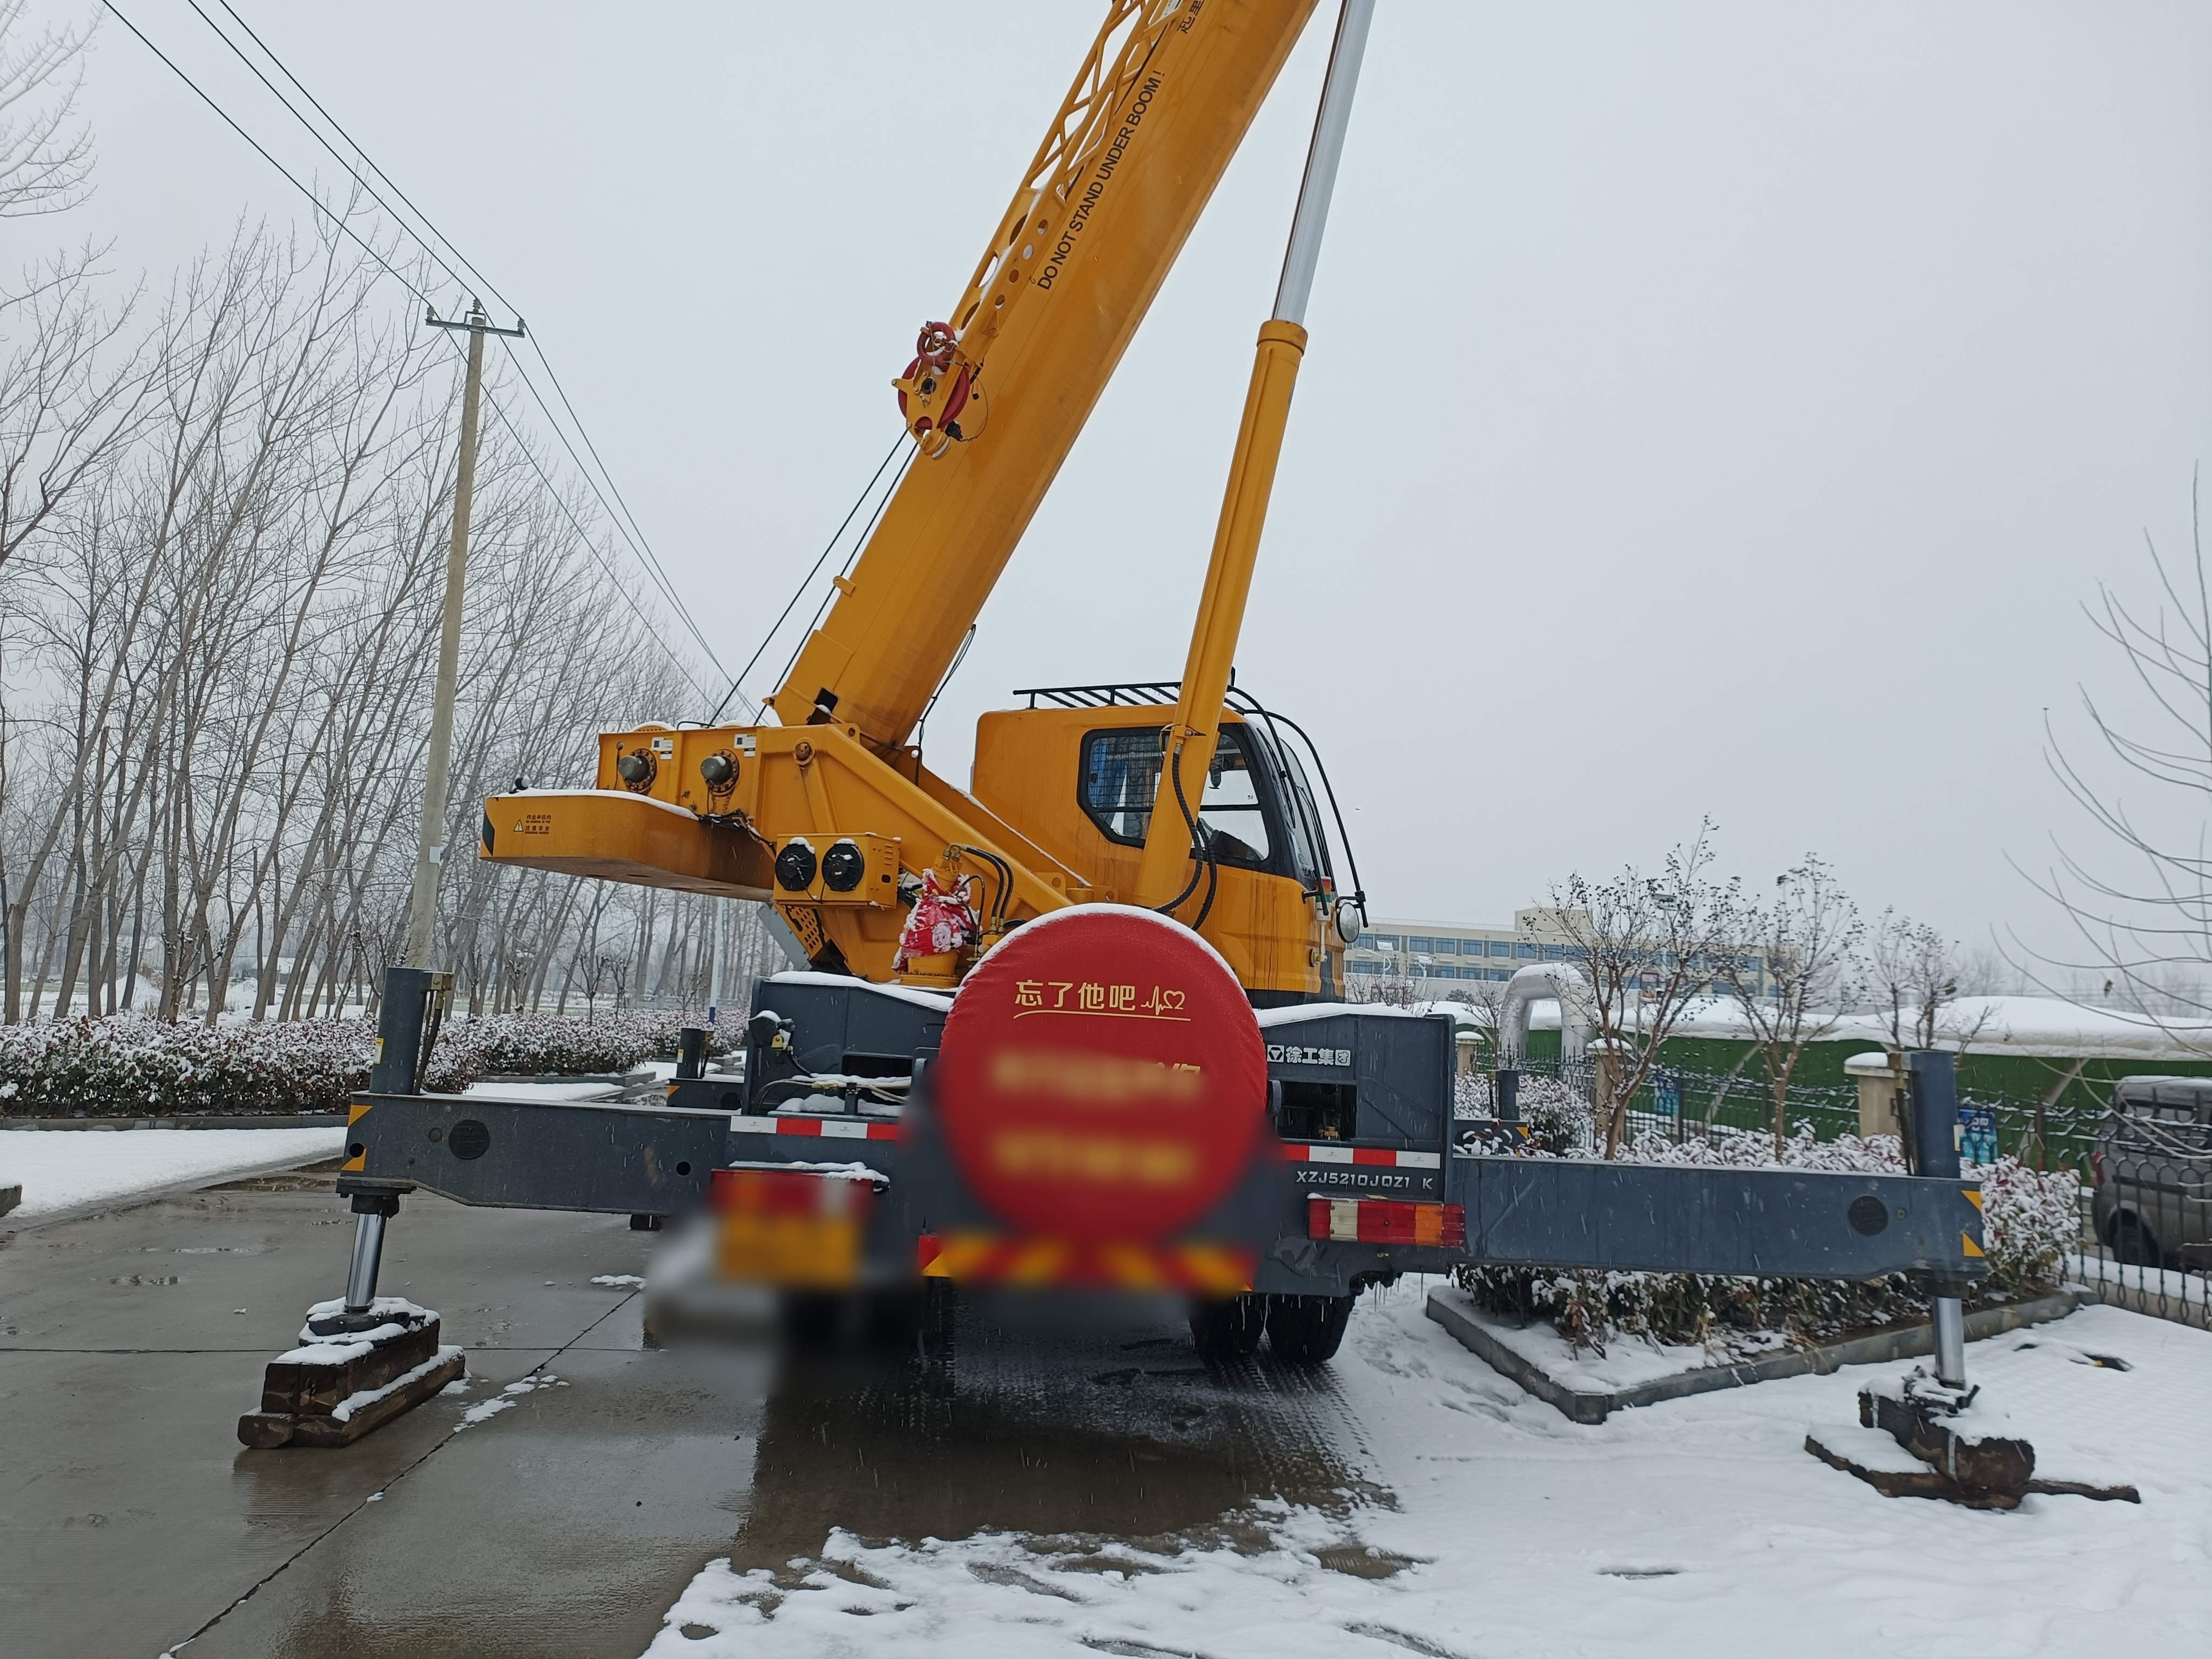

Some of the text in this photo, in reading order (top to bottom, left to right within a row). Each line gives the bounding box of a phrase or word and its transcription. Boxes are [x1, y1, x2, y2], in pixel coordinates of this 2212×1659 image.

[1037, 265, 1058, 290] DO
[1050, 231, 1076, 265] NOT
[1069, 181, 1104, 232] STAND
[1096, 126, 1135, 180] UNDER
[1015, 979, 1136, 1011] 忘了他吧
[1285, 1046, 1351, 1067] 徐工集团
[1296, 1170, 1433, 1190] XZJ5210JQZ1 K
